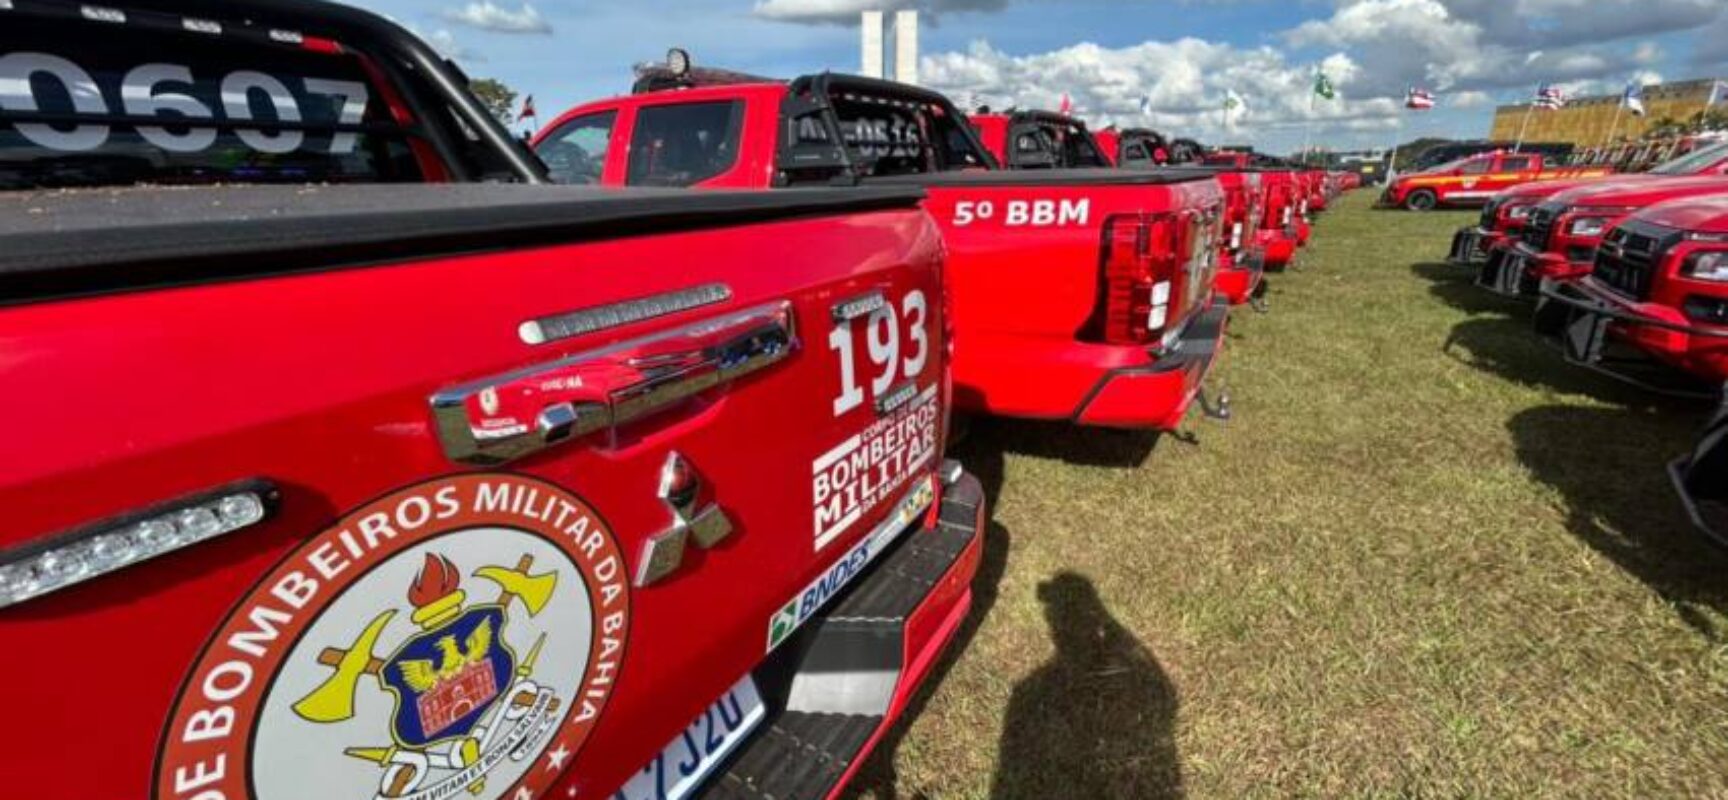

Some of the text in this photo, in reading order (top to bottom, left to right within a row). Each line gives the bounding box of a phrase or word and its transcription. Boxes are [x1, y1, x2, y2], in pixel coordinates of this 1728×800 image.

[0, 52, 367, 153] 0607
[953, 198, 1090, 226] 5º BBM
[829, 289, 928, 416] 193
[814, 397, 937, 504] BOMBEIROS
[815, 424, 935, 537] MILITAR
[473, 482, 605, 560] MILITAR
[182, 486, 460, 743] BOMBEIROS
[594, 555, 623, 606] DA
[799, 539, 871, 620] BNDES
[573, 611, 625, 723] BAHIA
